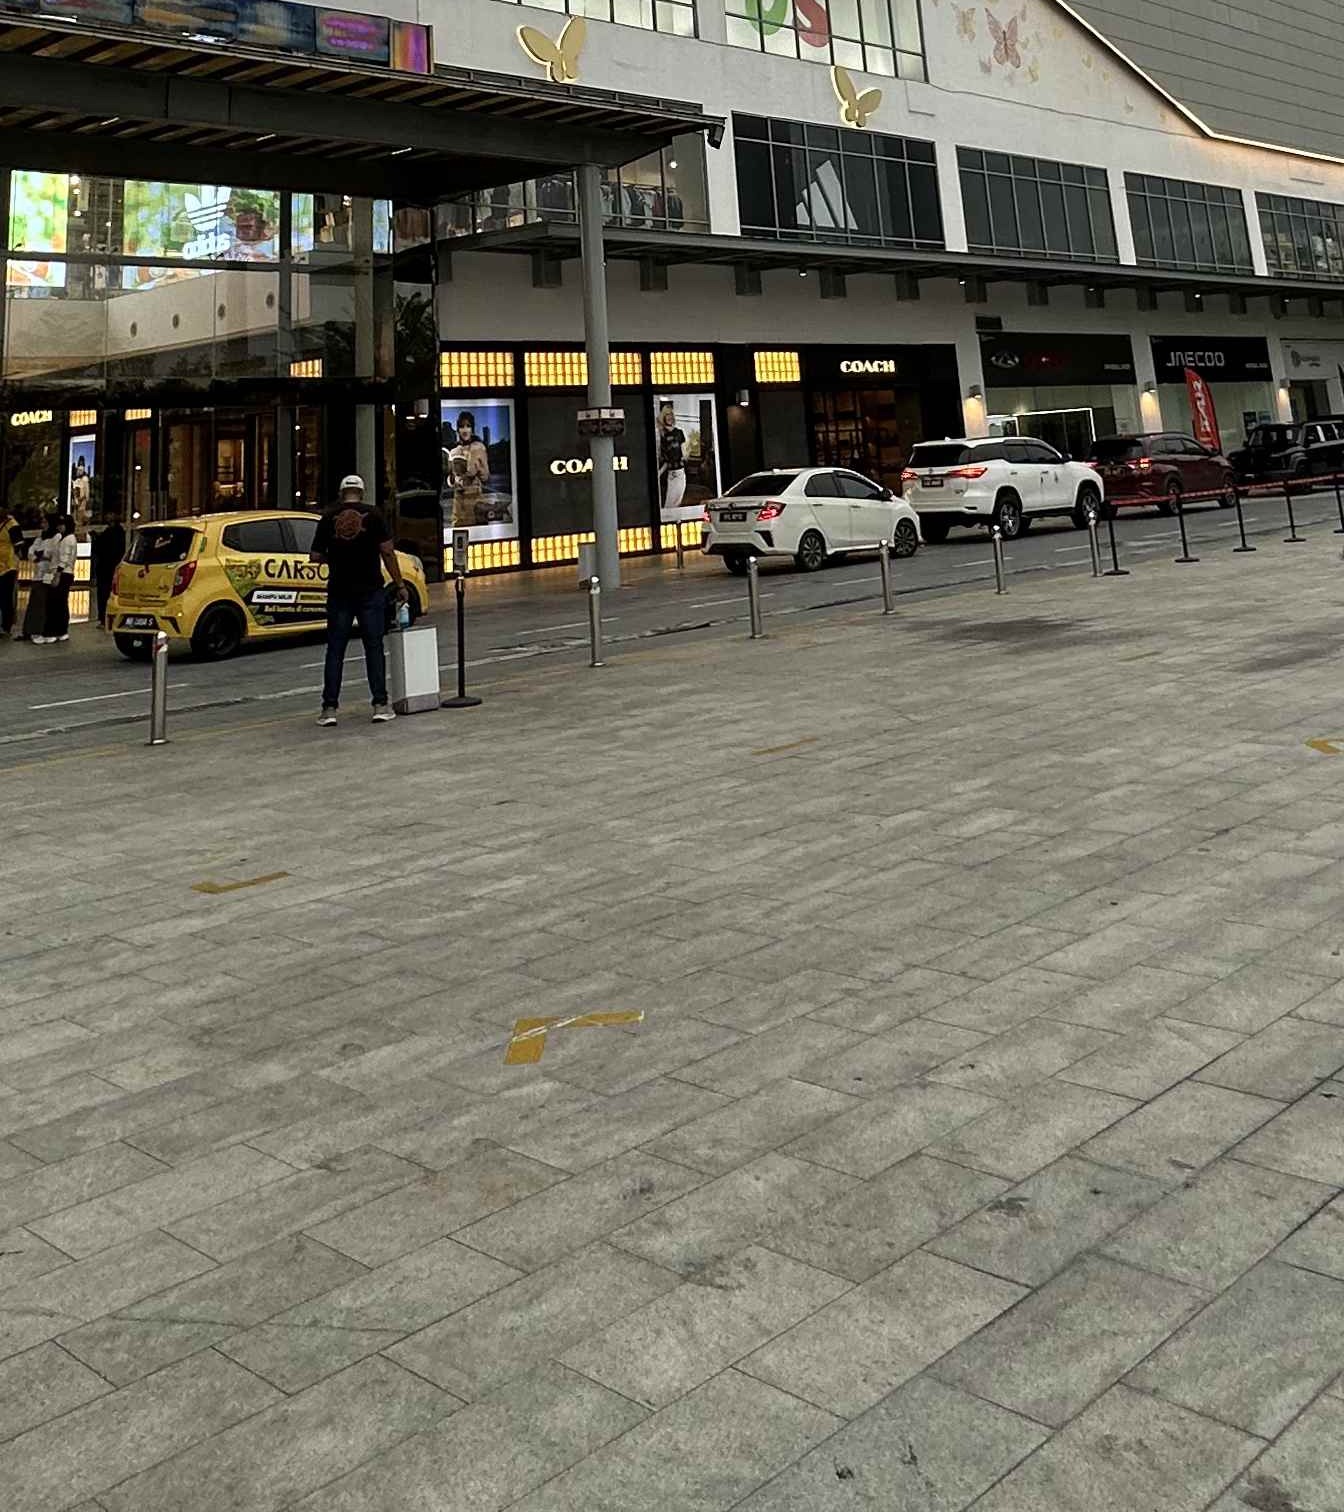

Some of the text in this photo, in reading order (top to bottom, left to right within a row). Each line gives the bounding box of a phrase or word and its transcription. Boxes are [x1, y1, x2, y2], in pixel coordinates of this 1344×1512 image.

[840, 359, 895, 373] COACH
[10, 410, 53, 427] COACH
[550, 456, 629, 477] COAH
[264, 558, 329, 581] CARSO
